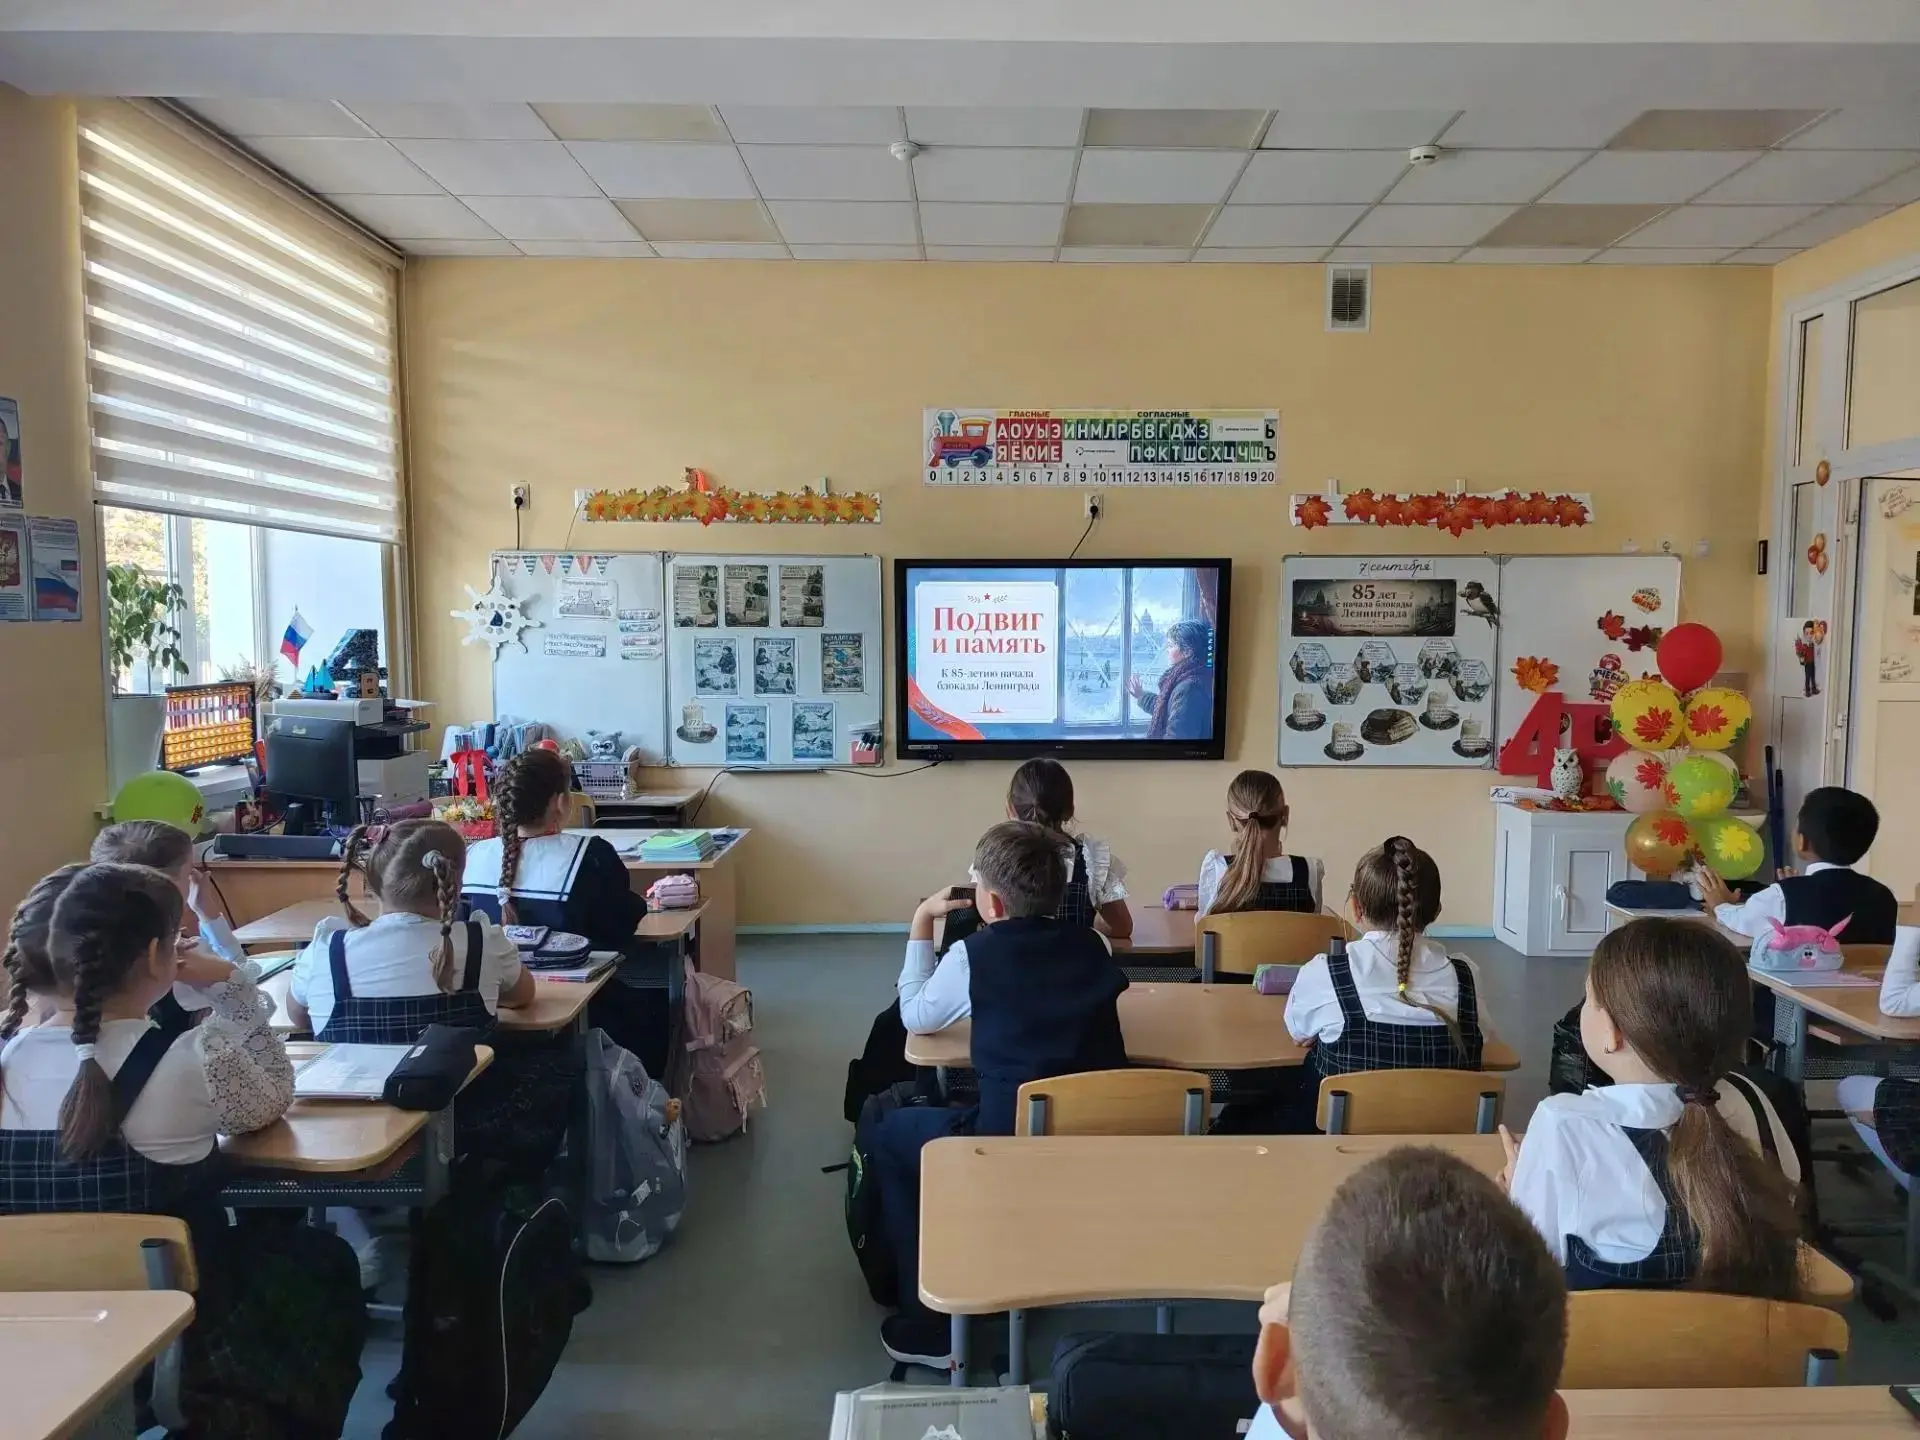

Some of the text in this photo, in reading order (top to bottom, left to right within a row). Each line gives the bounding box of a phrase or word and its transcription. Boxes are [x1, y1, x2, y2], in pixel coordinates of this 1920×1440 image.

[929, 471, 1275, 482] 0 1 2 3 4 5 6 7 8 9 10 11 12 13 14 15 16 17 18 19 20
[1352, 583, 1398, 600] 85 лет
[1375, 600, 1413, 609] блокады
[1341, 609, 1408, 620] Ленинграда
[934, 607, 1044, 635] Подвиг
[932, 638, 1046, 654] и память
[941, 668, 1034, 678] К 85-летию начала
[936, 681, 1040, 693] блокады Ленинграда
